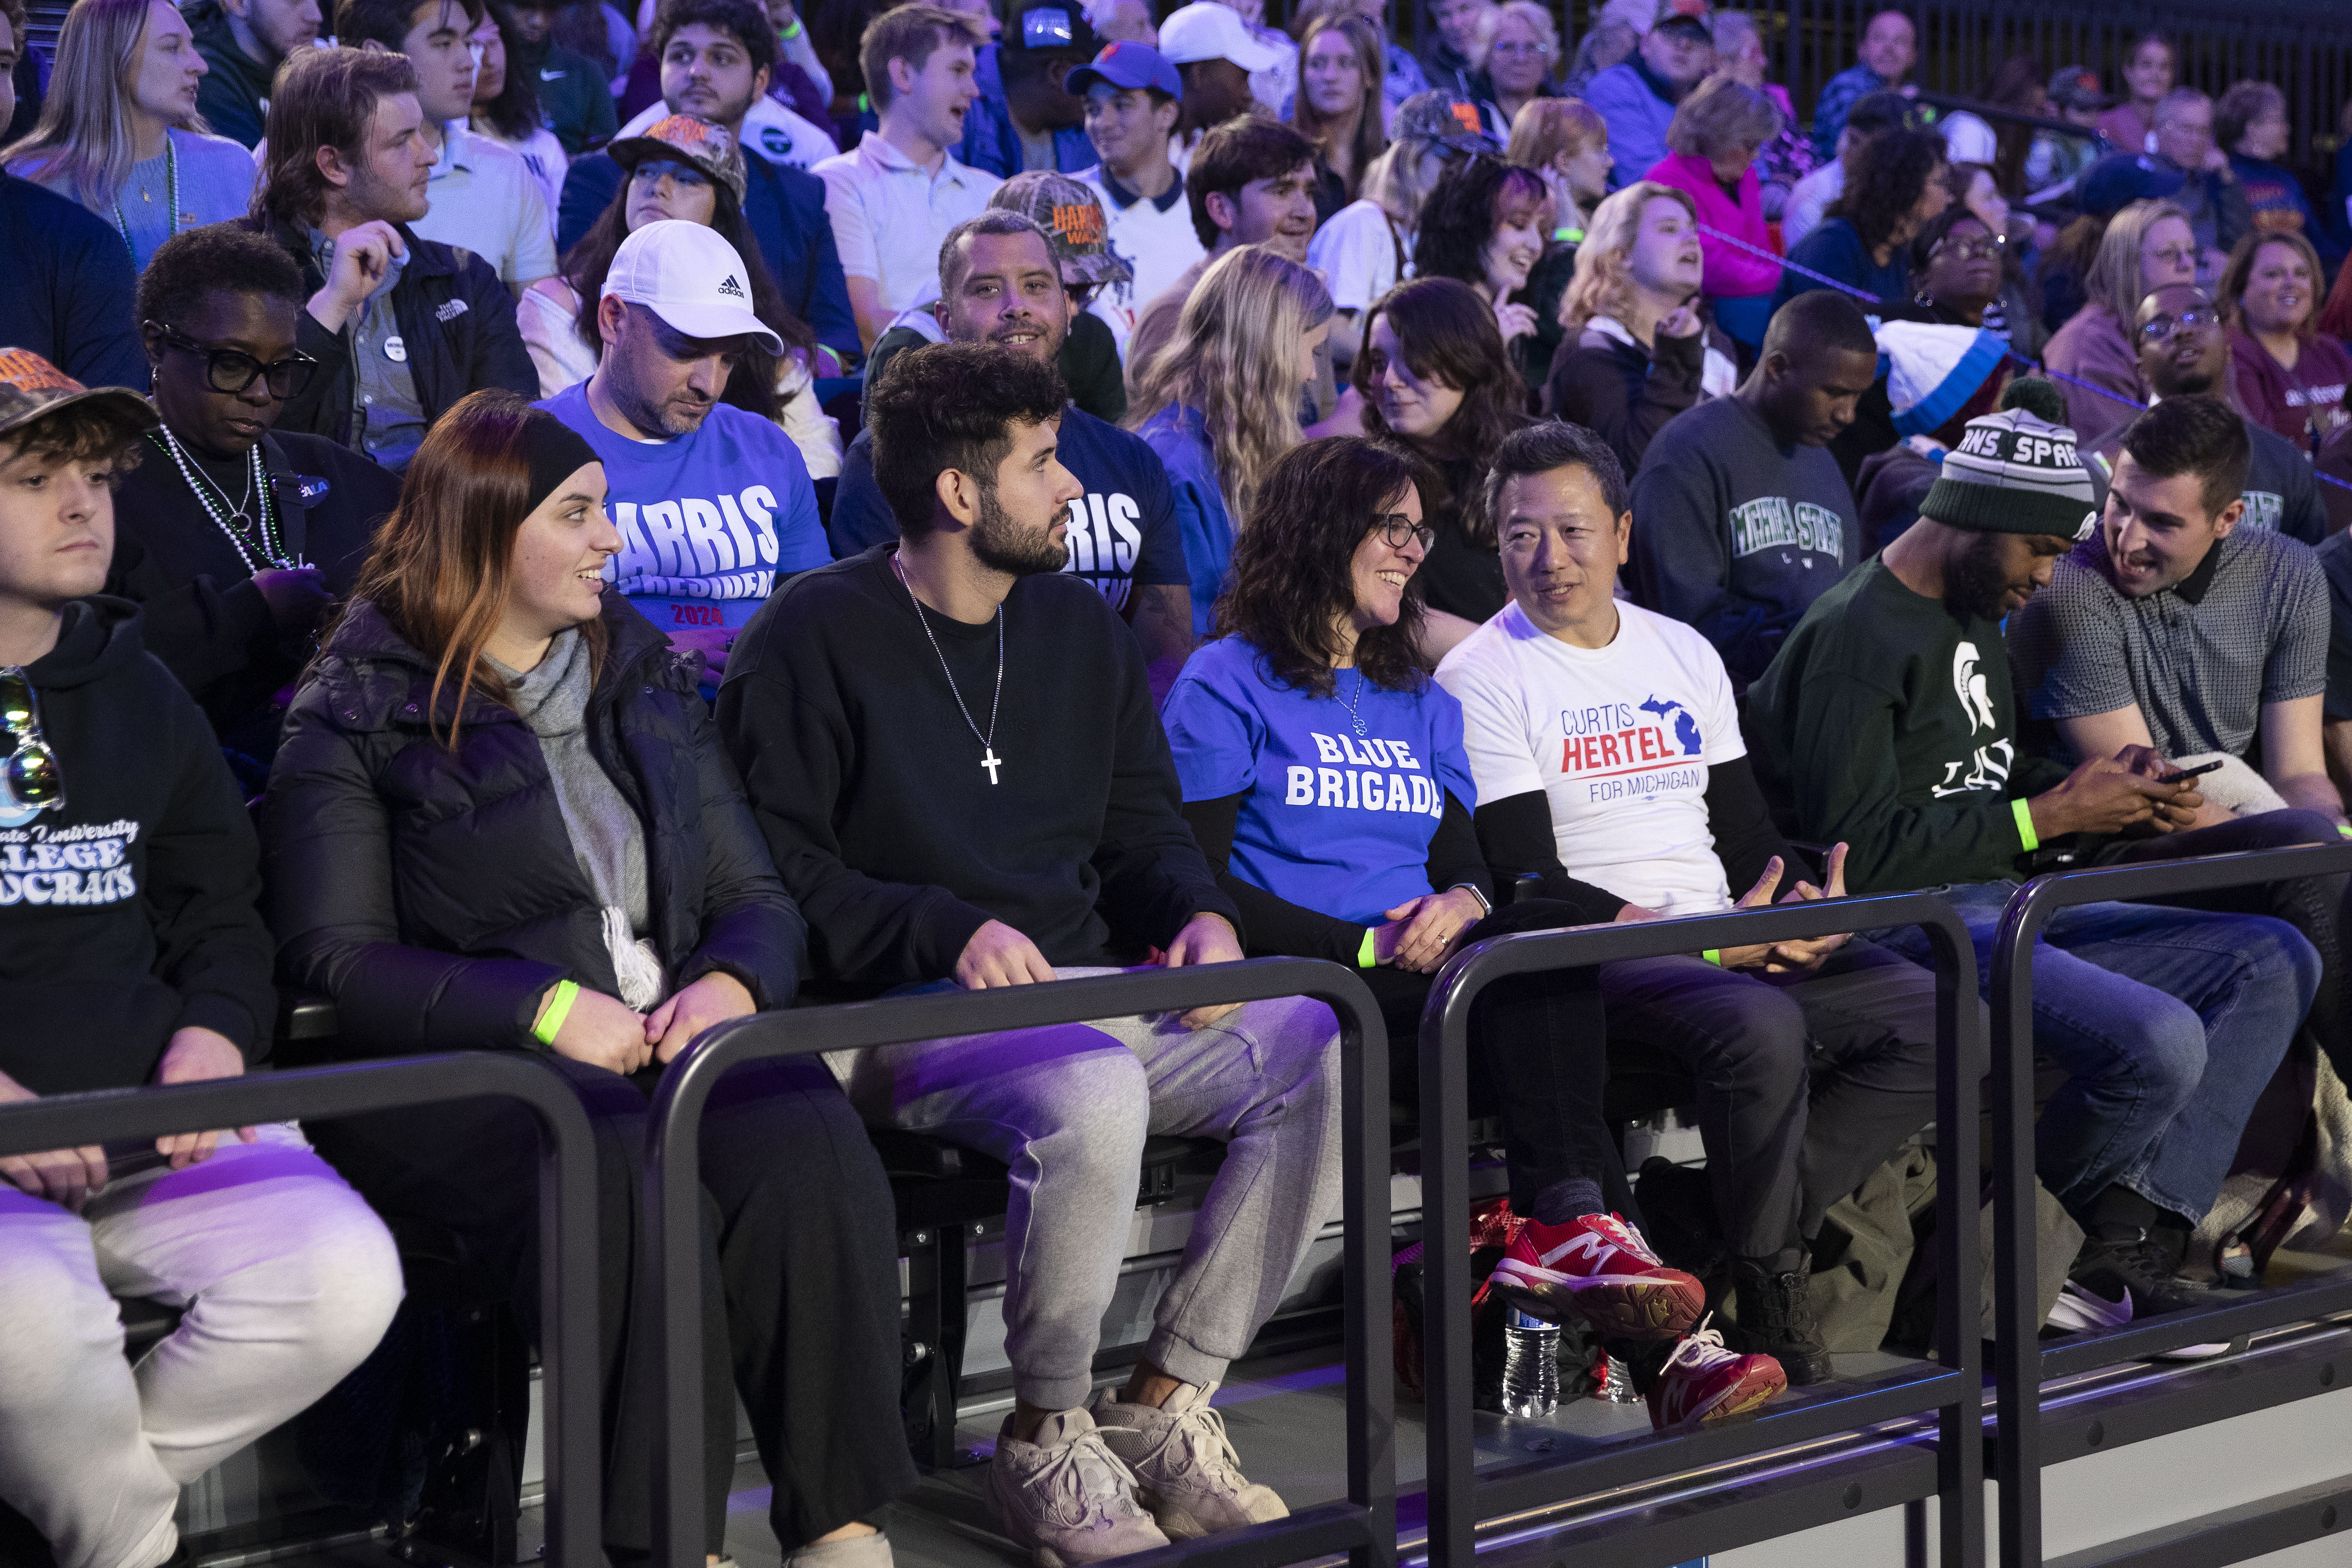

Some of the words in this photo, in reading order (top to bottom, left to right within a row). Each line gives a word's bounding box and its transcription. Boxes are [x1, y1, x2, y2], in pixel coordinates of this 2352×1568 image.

[718, 286, 744, 298] adidas
[617, 569, 776, 599] PRESIDEN
[671, 604, 723, 626] 2024
[1561, 704, 1634, 735] CURTIS
[1310, 732, 1420, 769] BLUE
[1561, 727, 1675, 773] HERTEL
[1285, 766, 1442, 819] BRIGADE
[1590, 781, 1622, 802] FOR
[1627, 770, 1699, 796] MICHIGAN
[31, 820, 139, 843] University
